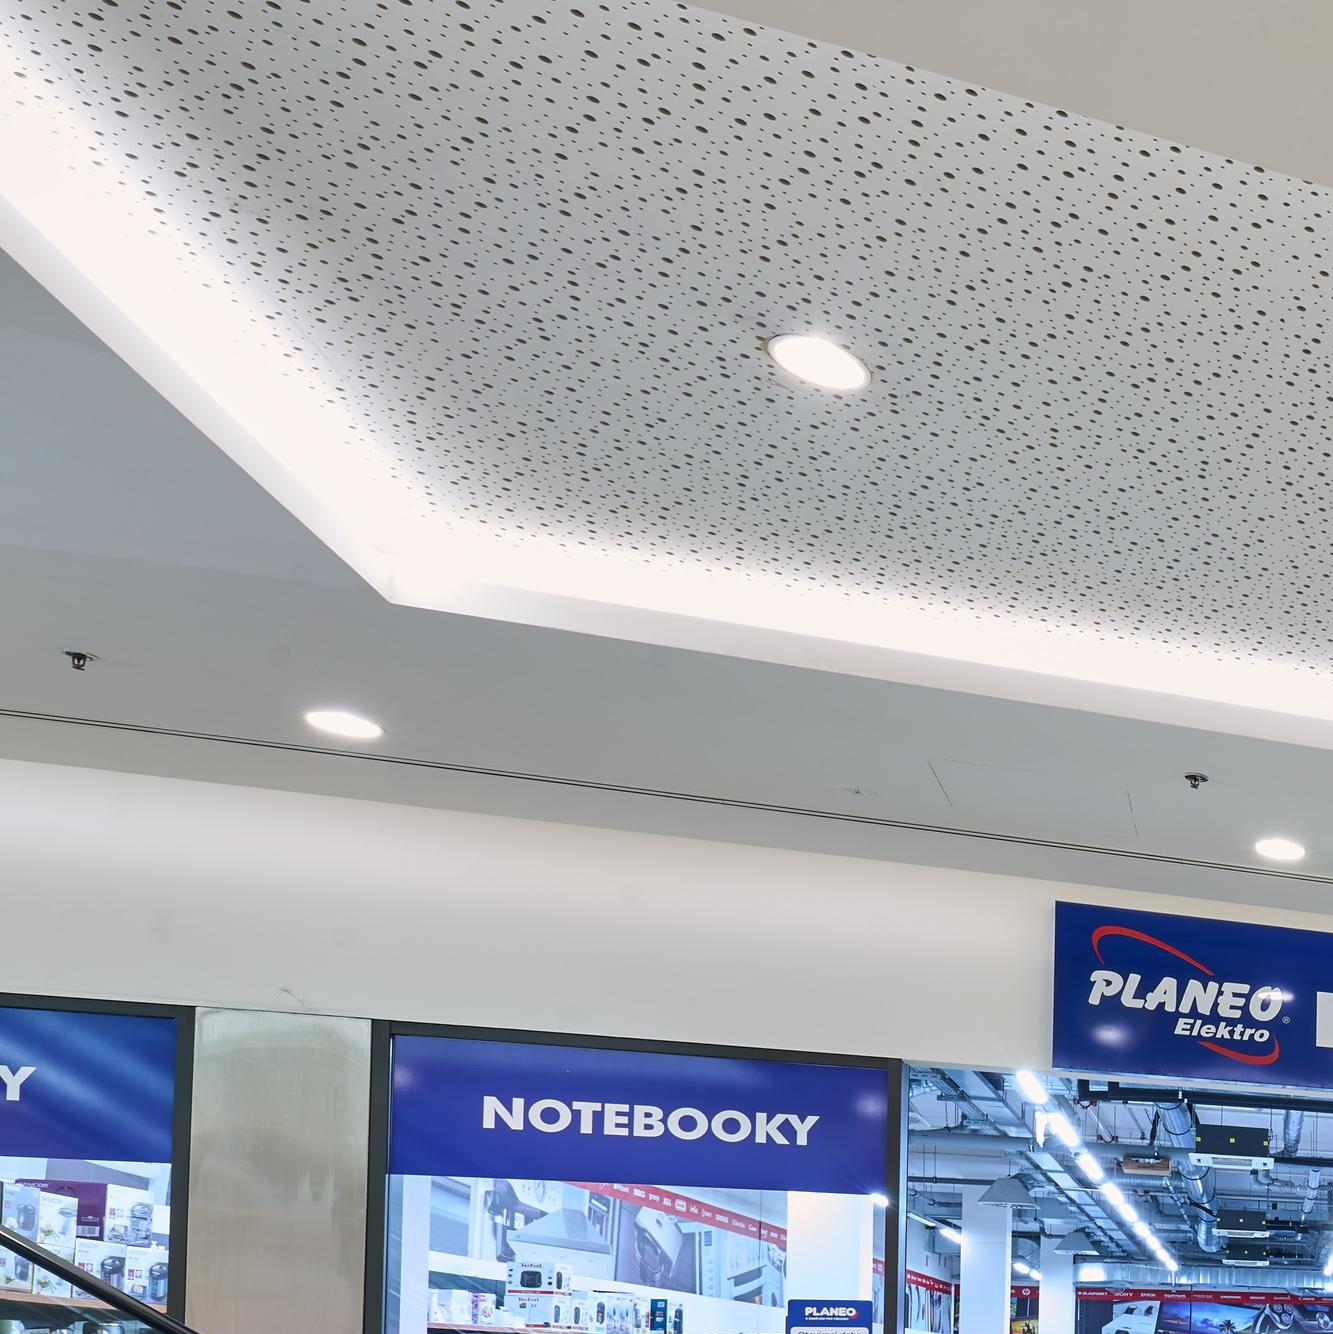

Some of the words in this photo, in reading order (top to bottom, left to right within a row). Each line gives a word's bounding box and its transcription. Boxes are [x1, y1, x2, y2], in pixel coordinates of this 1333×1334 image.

[1088, 969, 1283, 1022] PLANEO
[1174, 1018, 1270, 1043] Elektro
[482, 1094, 820, 1147] NOTEBOOKY
[805, 1306, 857, 1316] PLANEO
